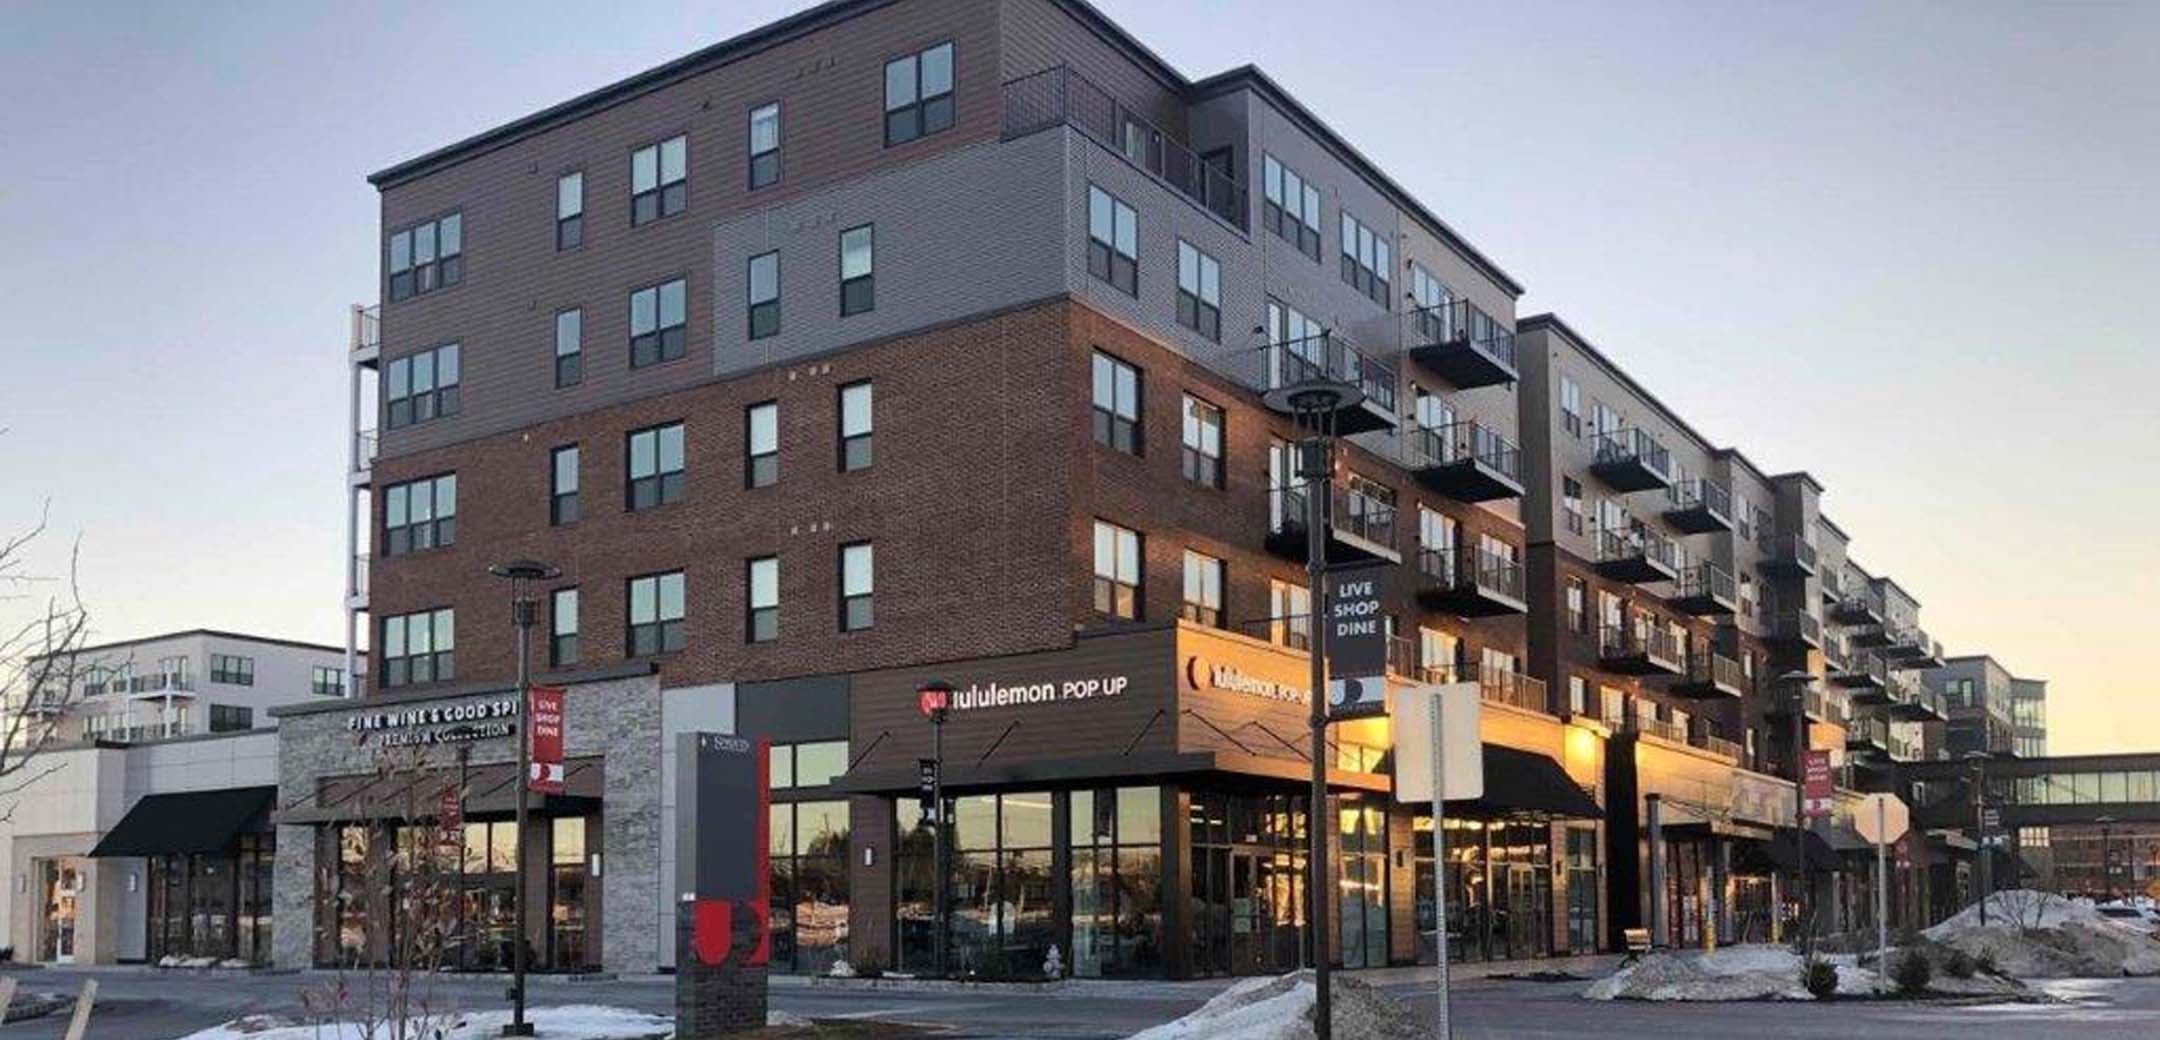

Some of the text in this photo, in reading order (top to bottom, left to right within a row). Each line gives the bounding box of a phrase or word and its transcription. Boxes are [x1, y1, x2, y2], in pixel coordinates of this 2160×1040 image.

[1340, 582, 1372, 598] LIVE
[1334, 600, 1379, 617] SHOP
[1337, 620, 1377, 636] DINE
[953, 676, 1128, 710] lululemon POP UP
[348, 714, 381, 730] FINE
[387, 708, 426, 728] WINE
[444, 703, 487, 721] GOOD
[492, 700, 518, 717] SPI
[434, 721, 511, 745] COTION
